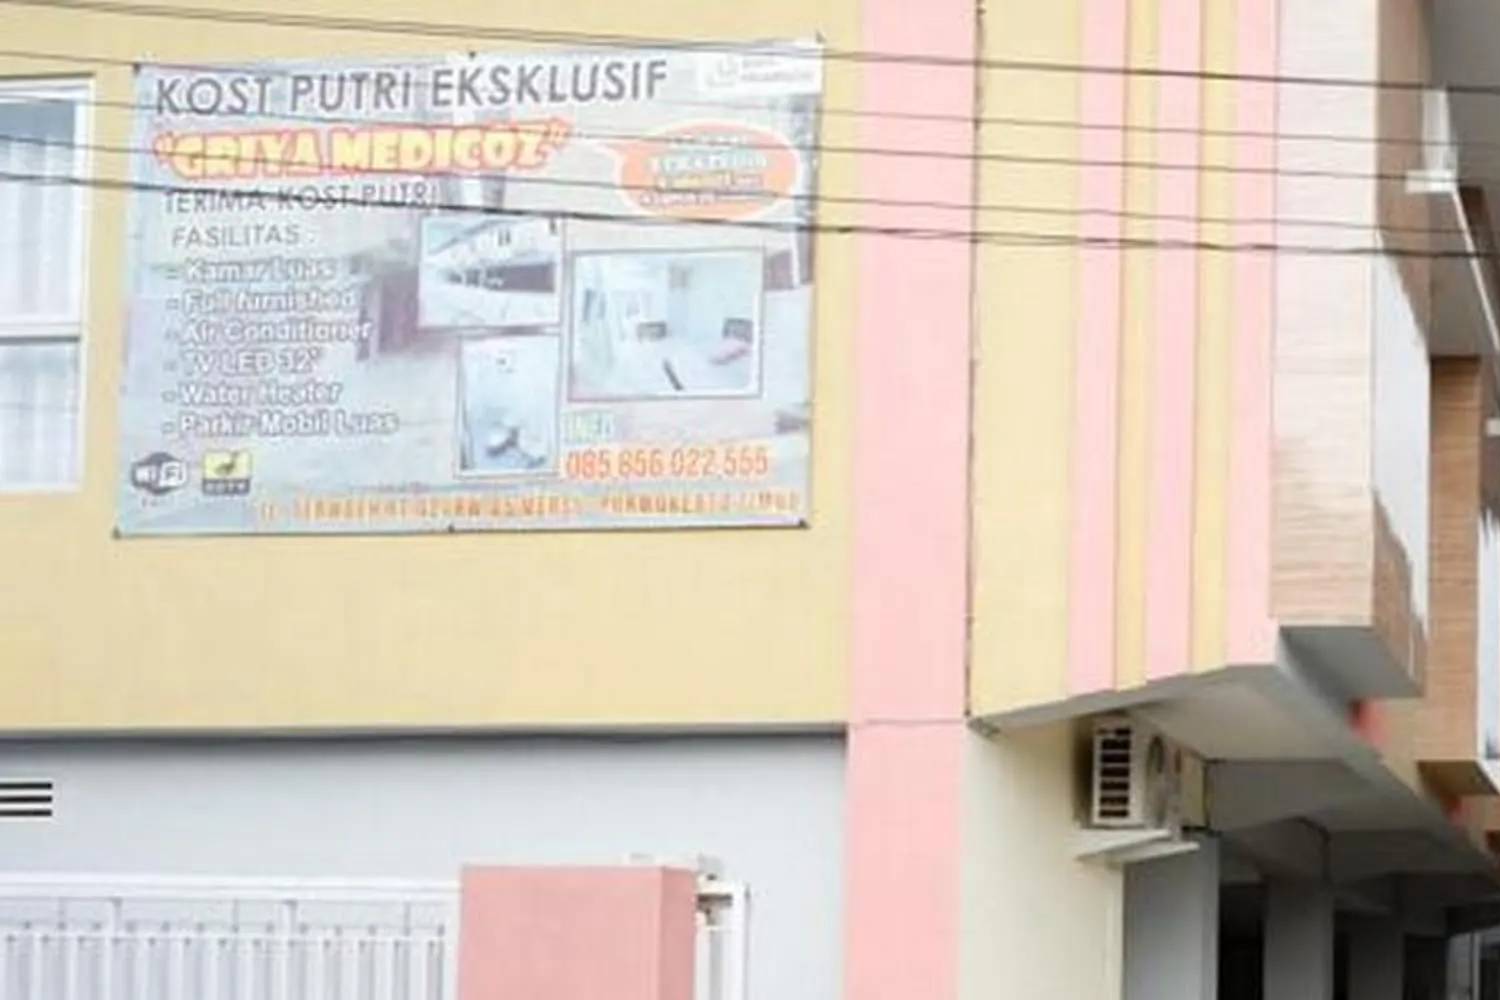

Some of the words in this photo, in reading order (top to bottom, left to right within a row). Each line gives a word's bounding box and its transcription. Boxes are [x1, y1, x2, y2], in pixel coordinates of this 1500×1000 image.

[157, 77, 272, 115] KOST
[291, 72, 411, 112] PUTRI
[431, 60, 667, 108] EKSKLUSIF
[163, 186, 267, 214] TERIMA
[277, 184, 351, 211] KOST
[362, 182, 440, 208] PUTRI
[185, 257, 268, 282] Kamar
[178, 381, 255, 406] Water
[179, 411, 256, 437] Parkir
[258, 409, 330, 436] Mobil
[565, 448, 611, 479] 085
[670, 447, 717, 477] 022
[723, 445, 769, 476] 555
